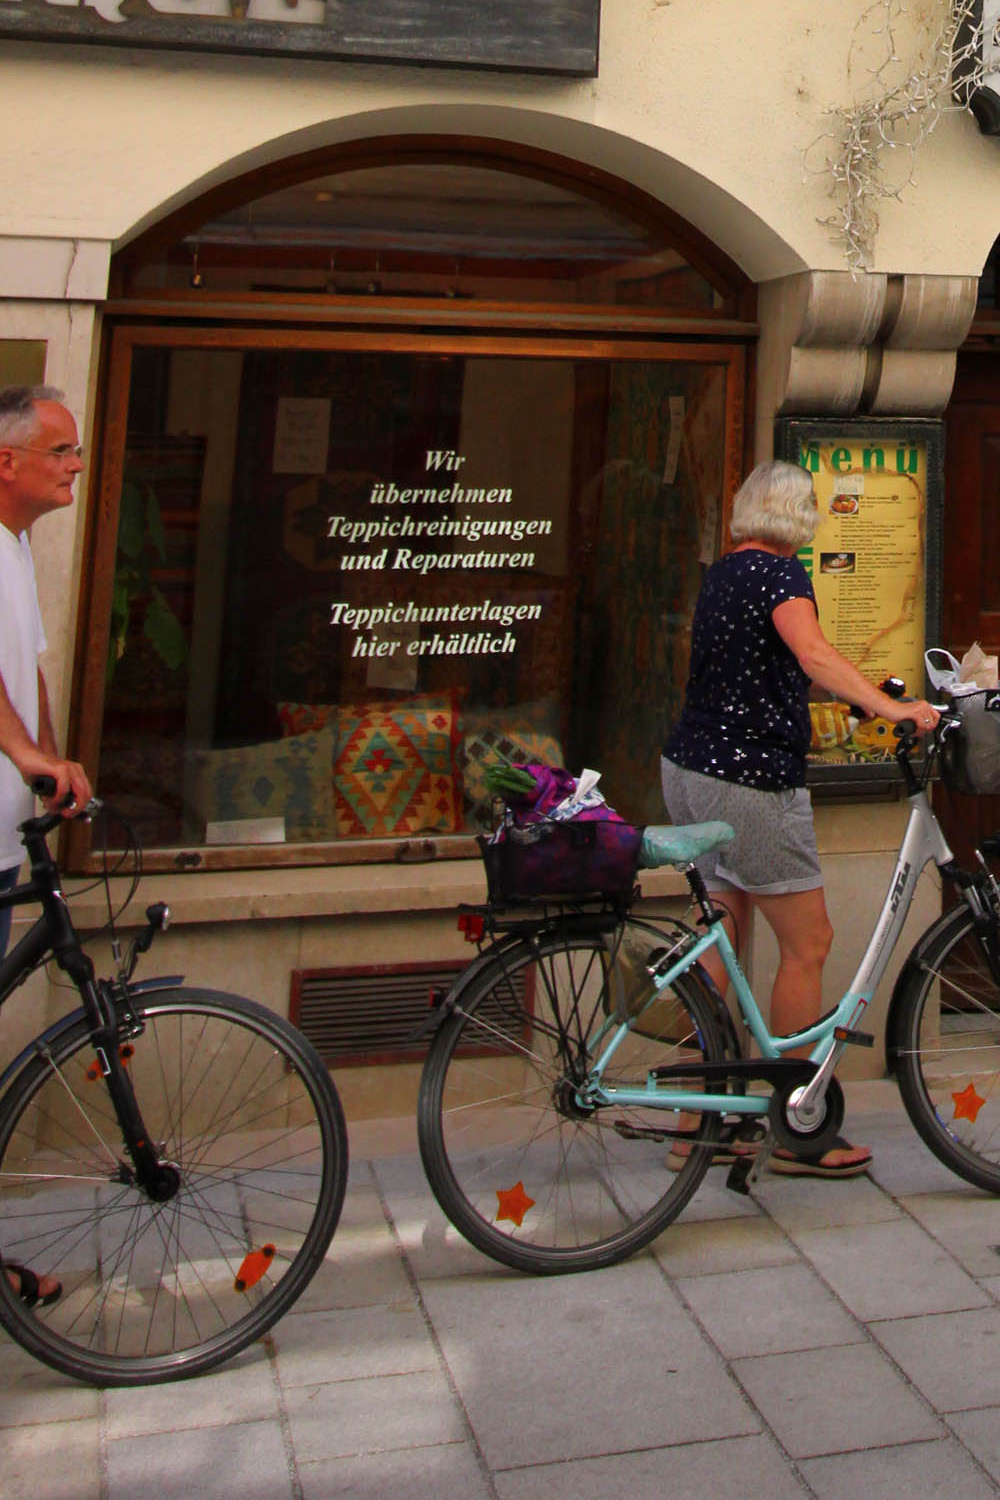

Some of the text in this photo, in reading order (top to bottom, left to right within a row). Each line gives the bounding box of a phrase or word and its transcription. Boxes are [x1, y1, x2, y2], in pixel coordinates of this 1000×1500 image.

[424, 450, 466, 472] Wir
[369, 482, 514, 505] übernehmen
[327, 515, 553, 544] Teppichreinigungen
[340, 548, 536, 576] und Reparaturen
[329, 600, 543, 631] Teppichunterlagen
[351, 632, 517, 658] hier erhältlich
[890, 861, 911, 916] KTM
